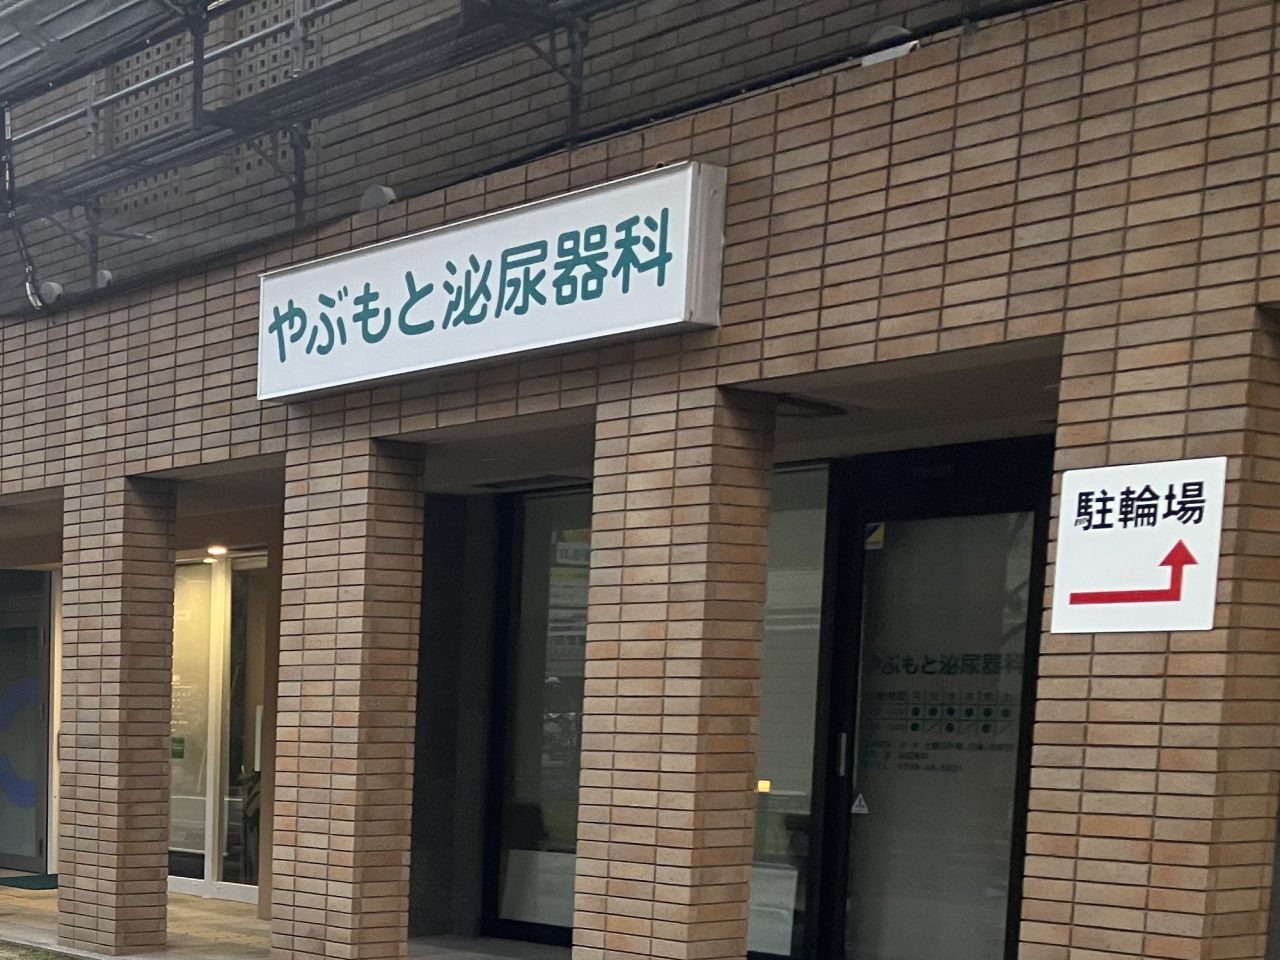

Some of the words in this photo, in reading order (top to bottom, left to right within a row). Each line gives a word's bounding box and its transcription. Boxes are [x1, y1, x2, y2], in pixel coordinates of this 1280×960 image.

[268, 207, 673, 364] やぶもと泌尿器科
[1074, 481, 1206, 531] 駐輪場
